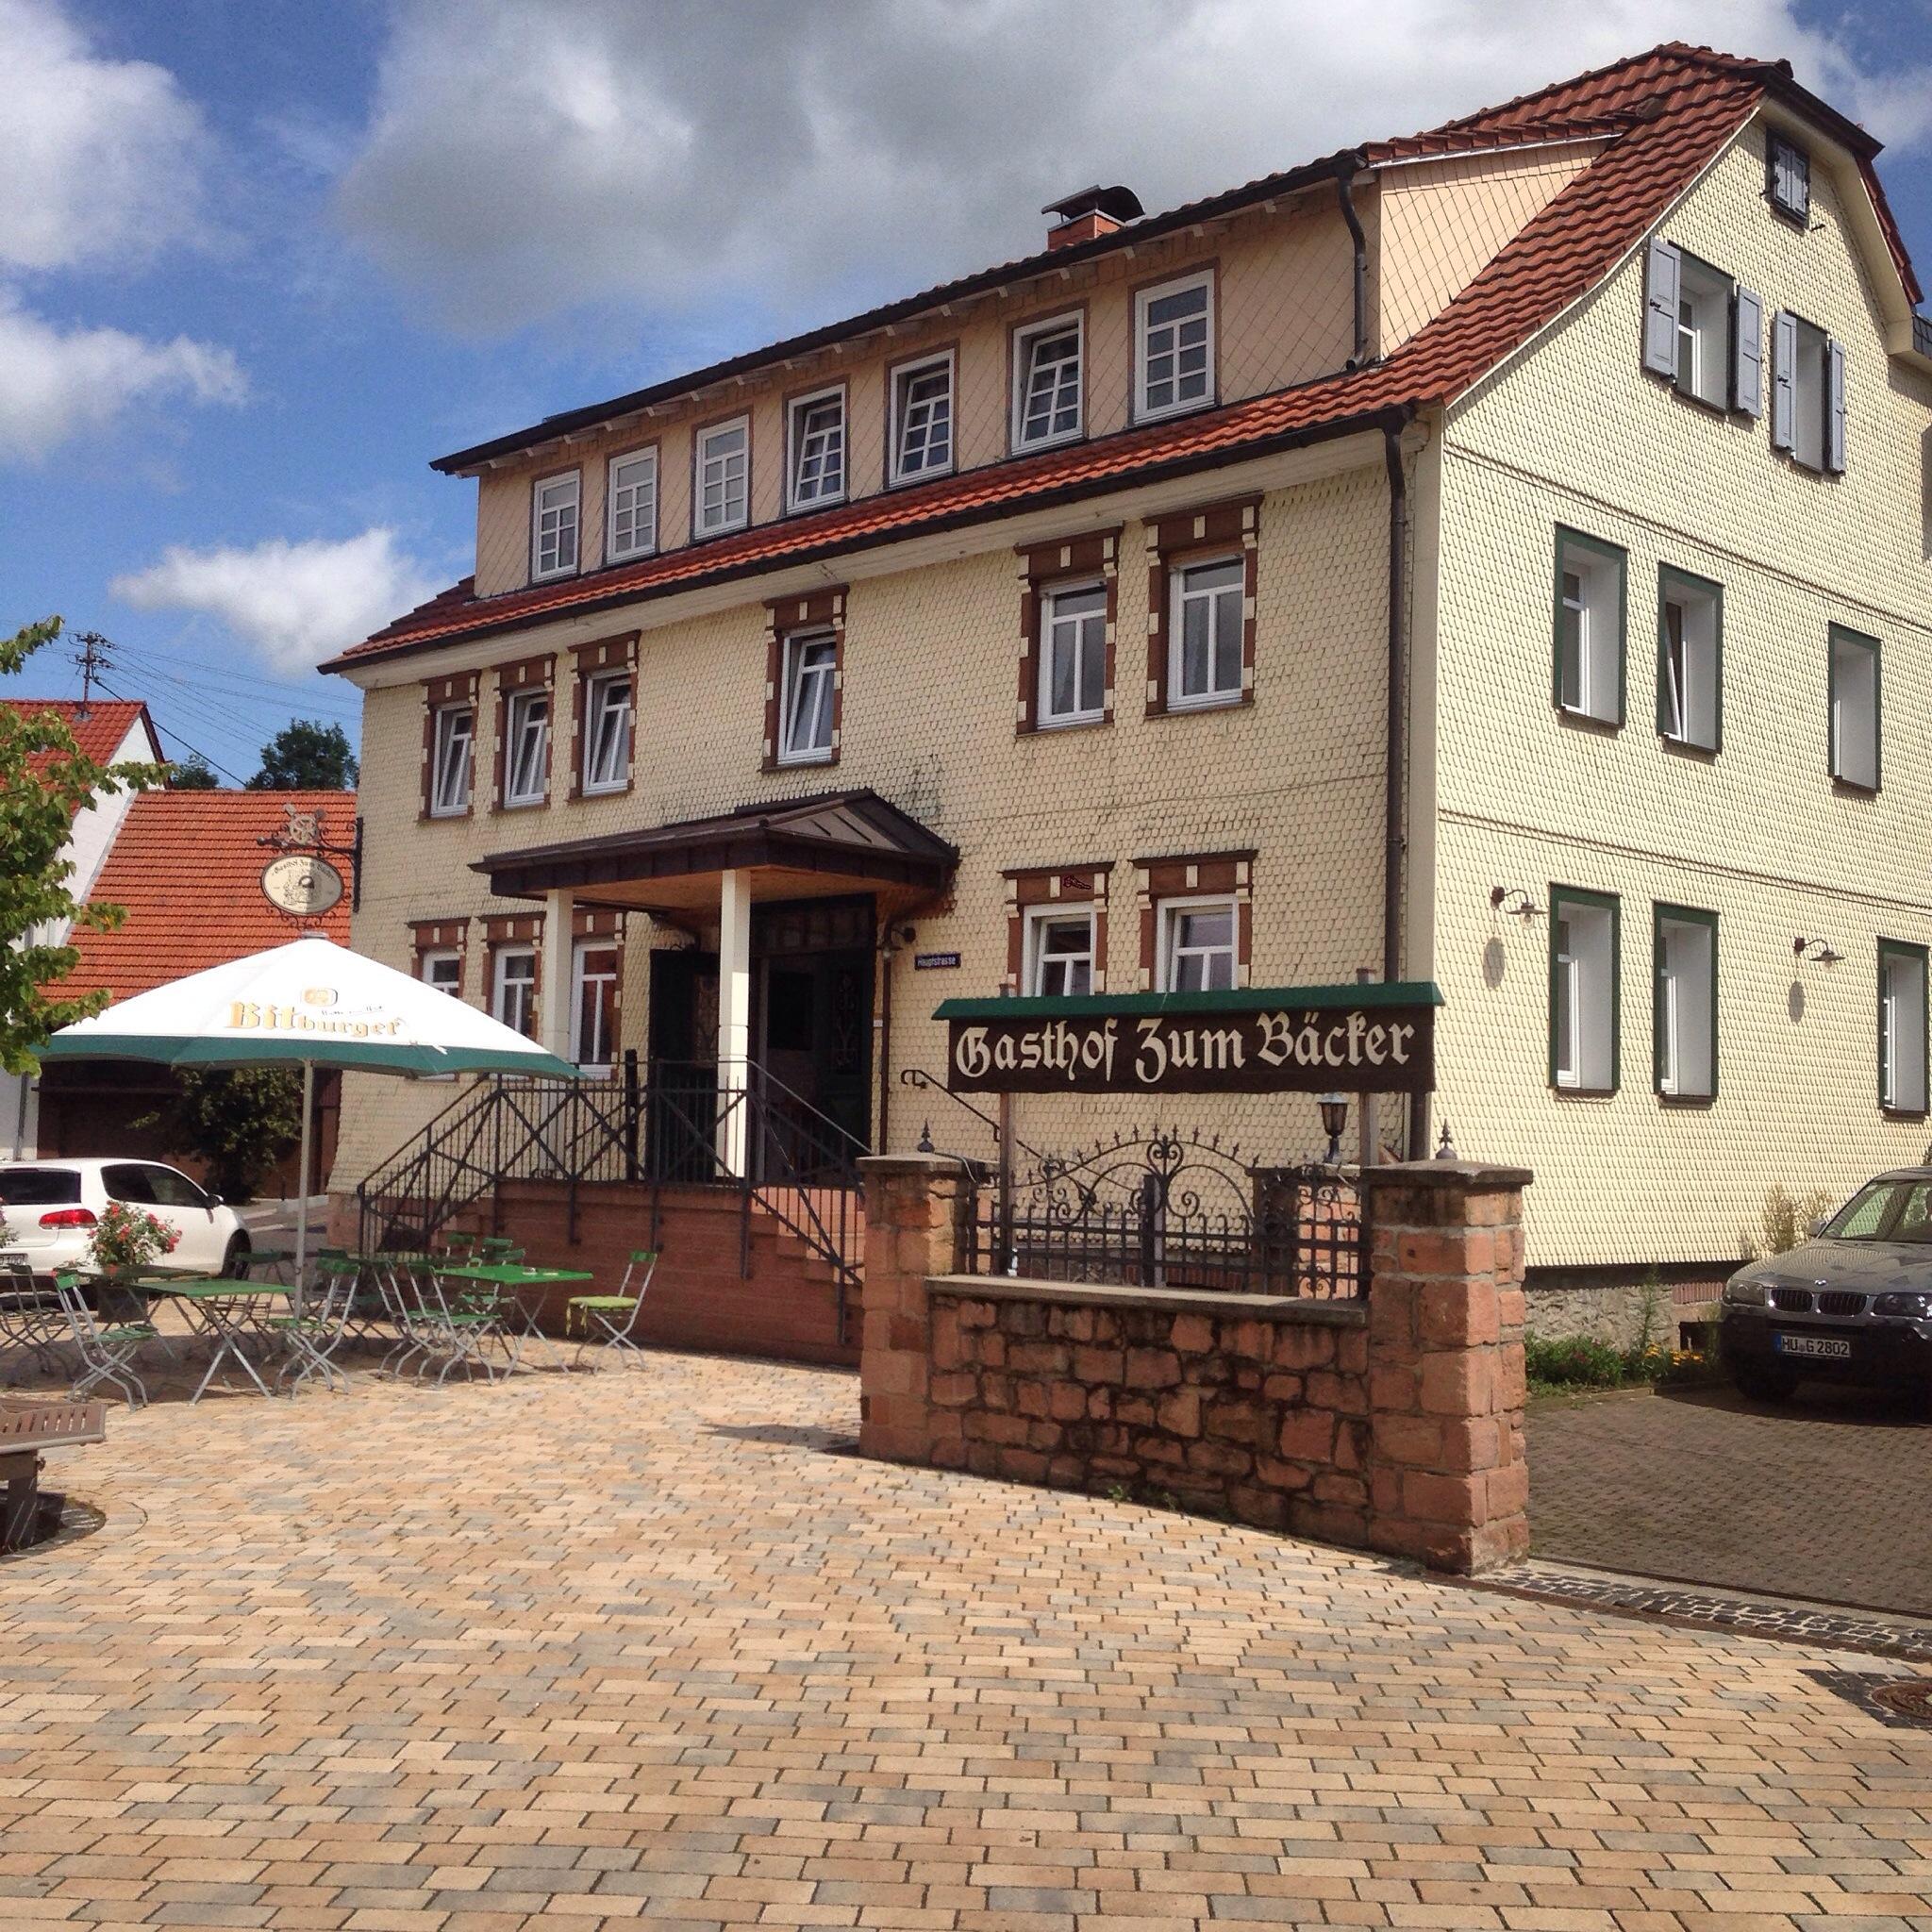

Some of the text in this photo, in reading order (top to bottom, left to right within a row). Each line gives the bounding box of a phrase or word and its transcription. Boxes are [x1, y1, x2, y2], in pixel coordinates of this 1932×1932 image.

[225, 1001, 404, 1038] Bitburger
[955, 1010, 1416, 1084] Gasthof Zum Bäcker
[1782, 1338, 1798, 1351] HU
[1817, 1341, 1849, 1356] 2802
